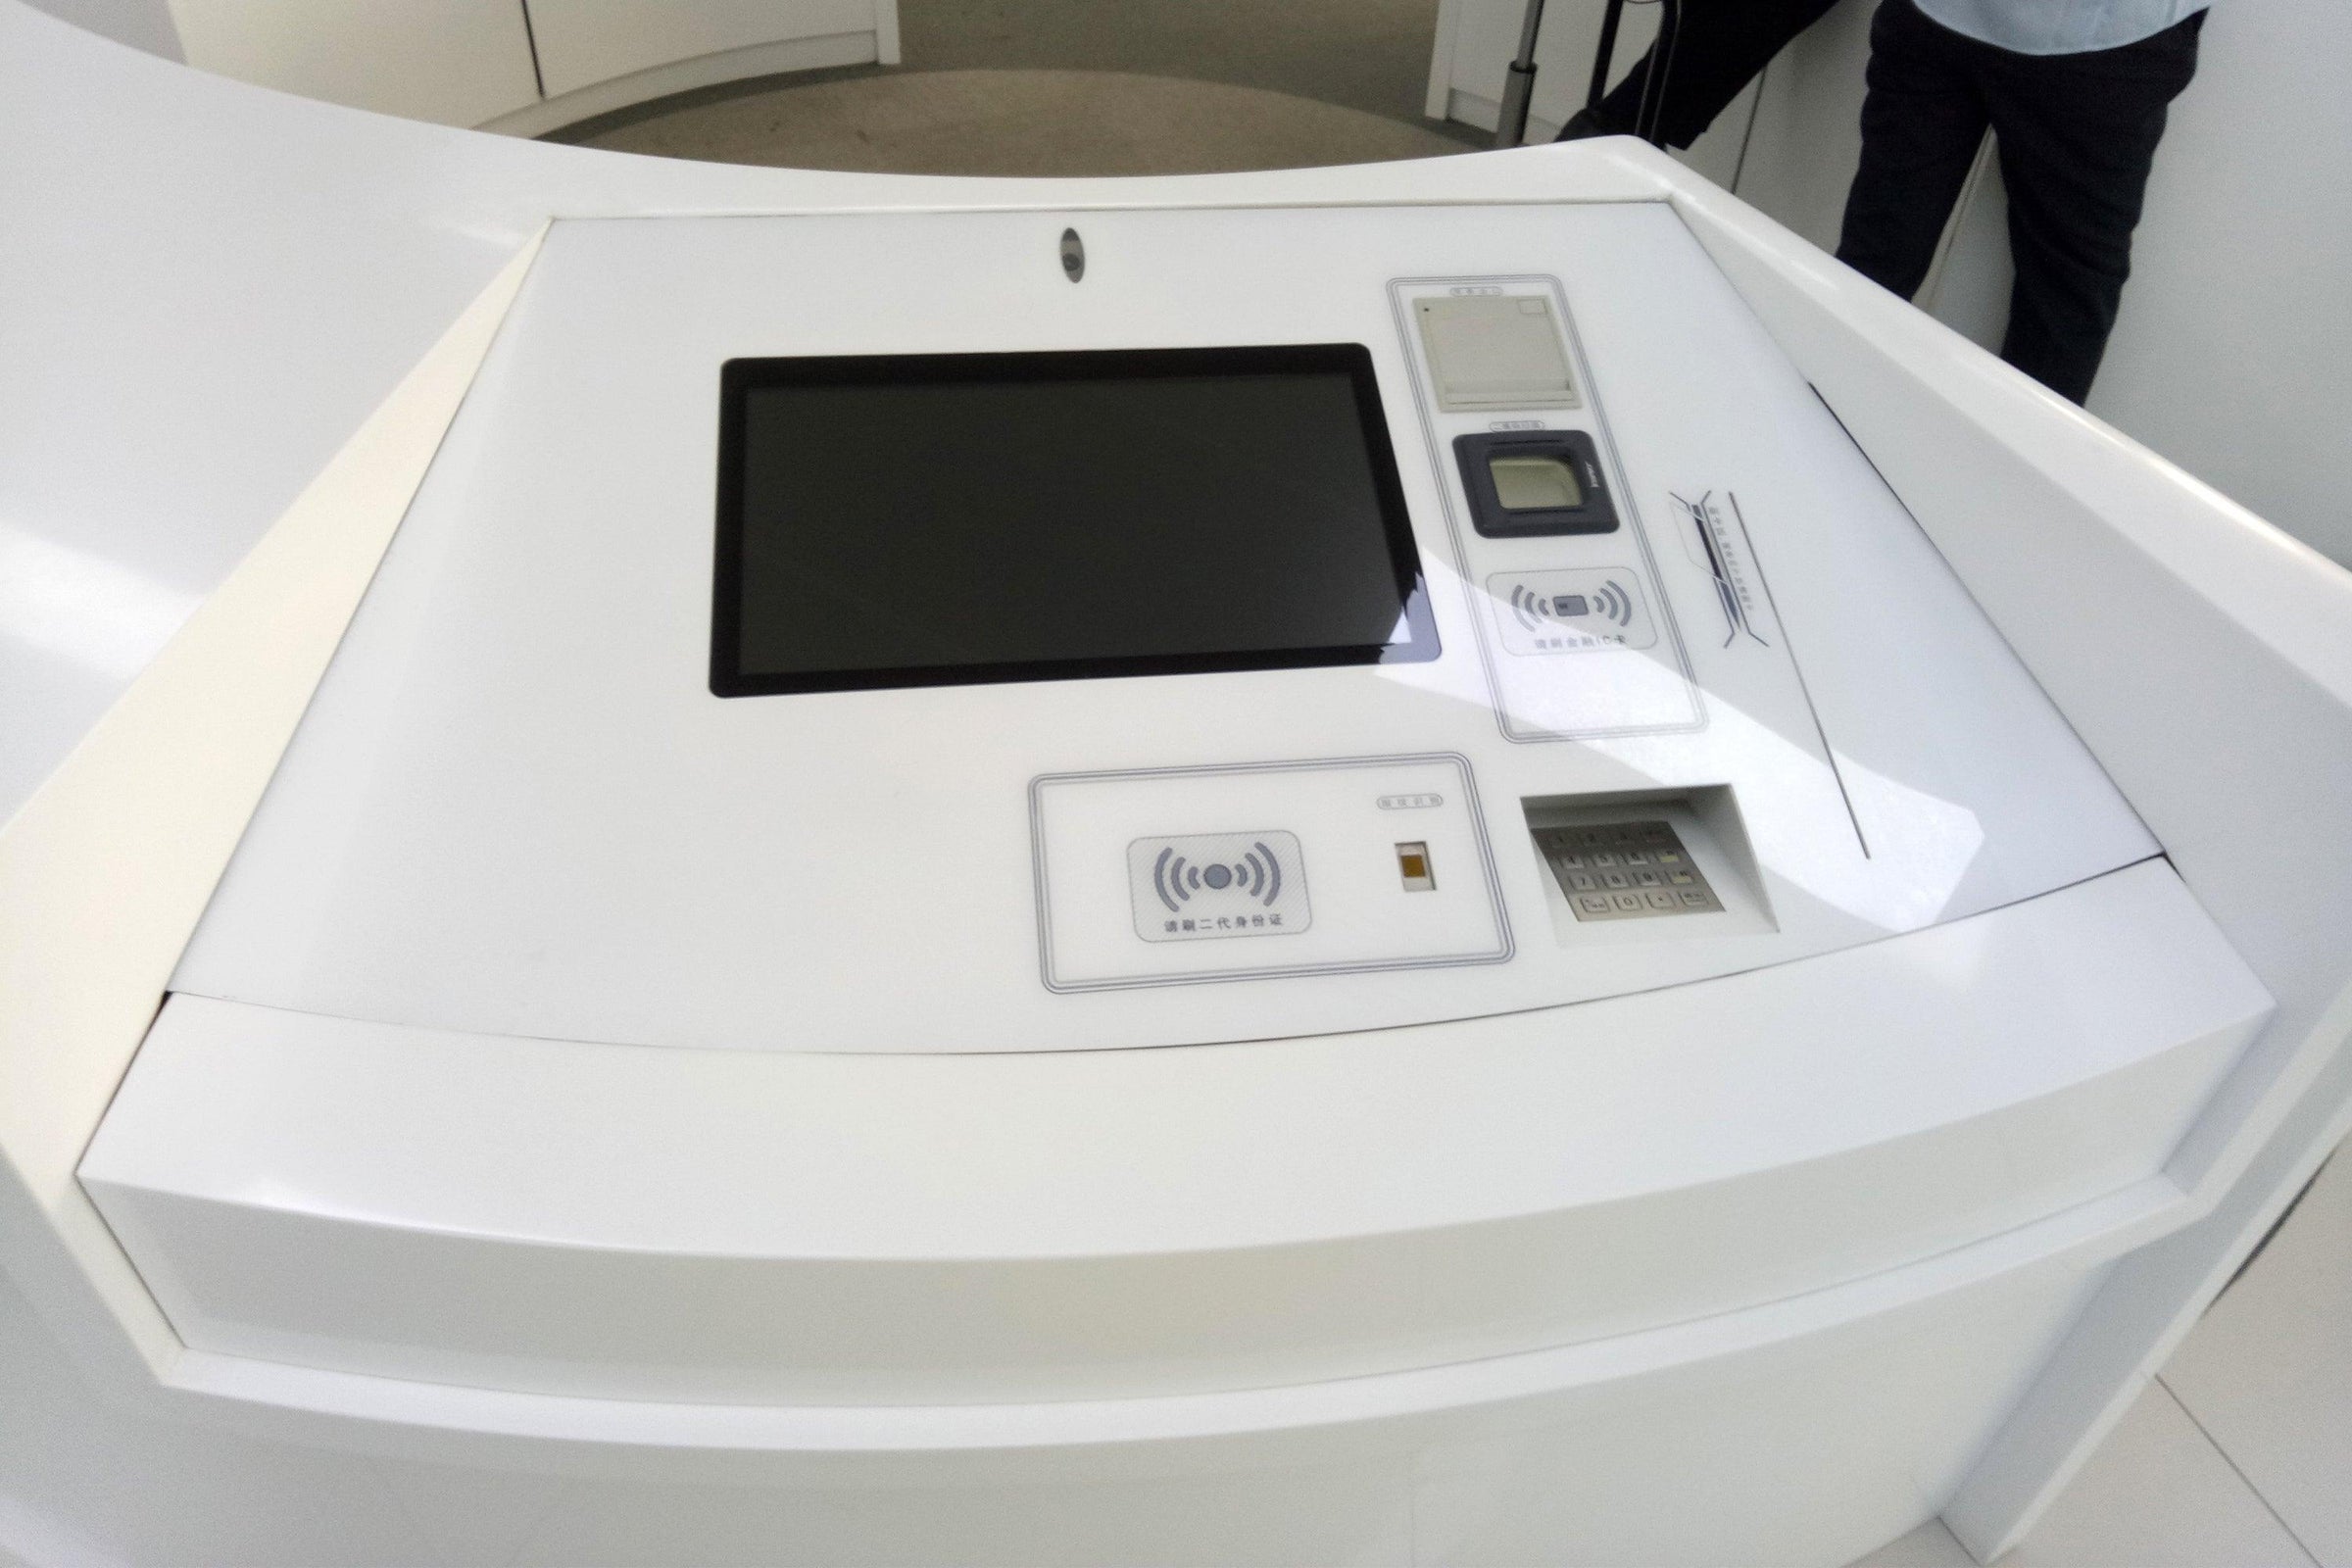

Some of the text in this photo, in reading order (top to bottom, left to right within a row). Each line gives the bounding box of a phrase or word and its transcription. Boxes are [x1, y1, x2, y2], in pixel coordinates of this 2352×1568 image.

[1163, 912, 1283, 933] 请刷二代身份证
